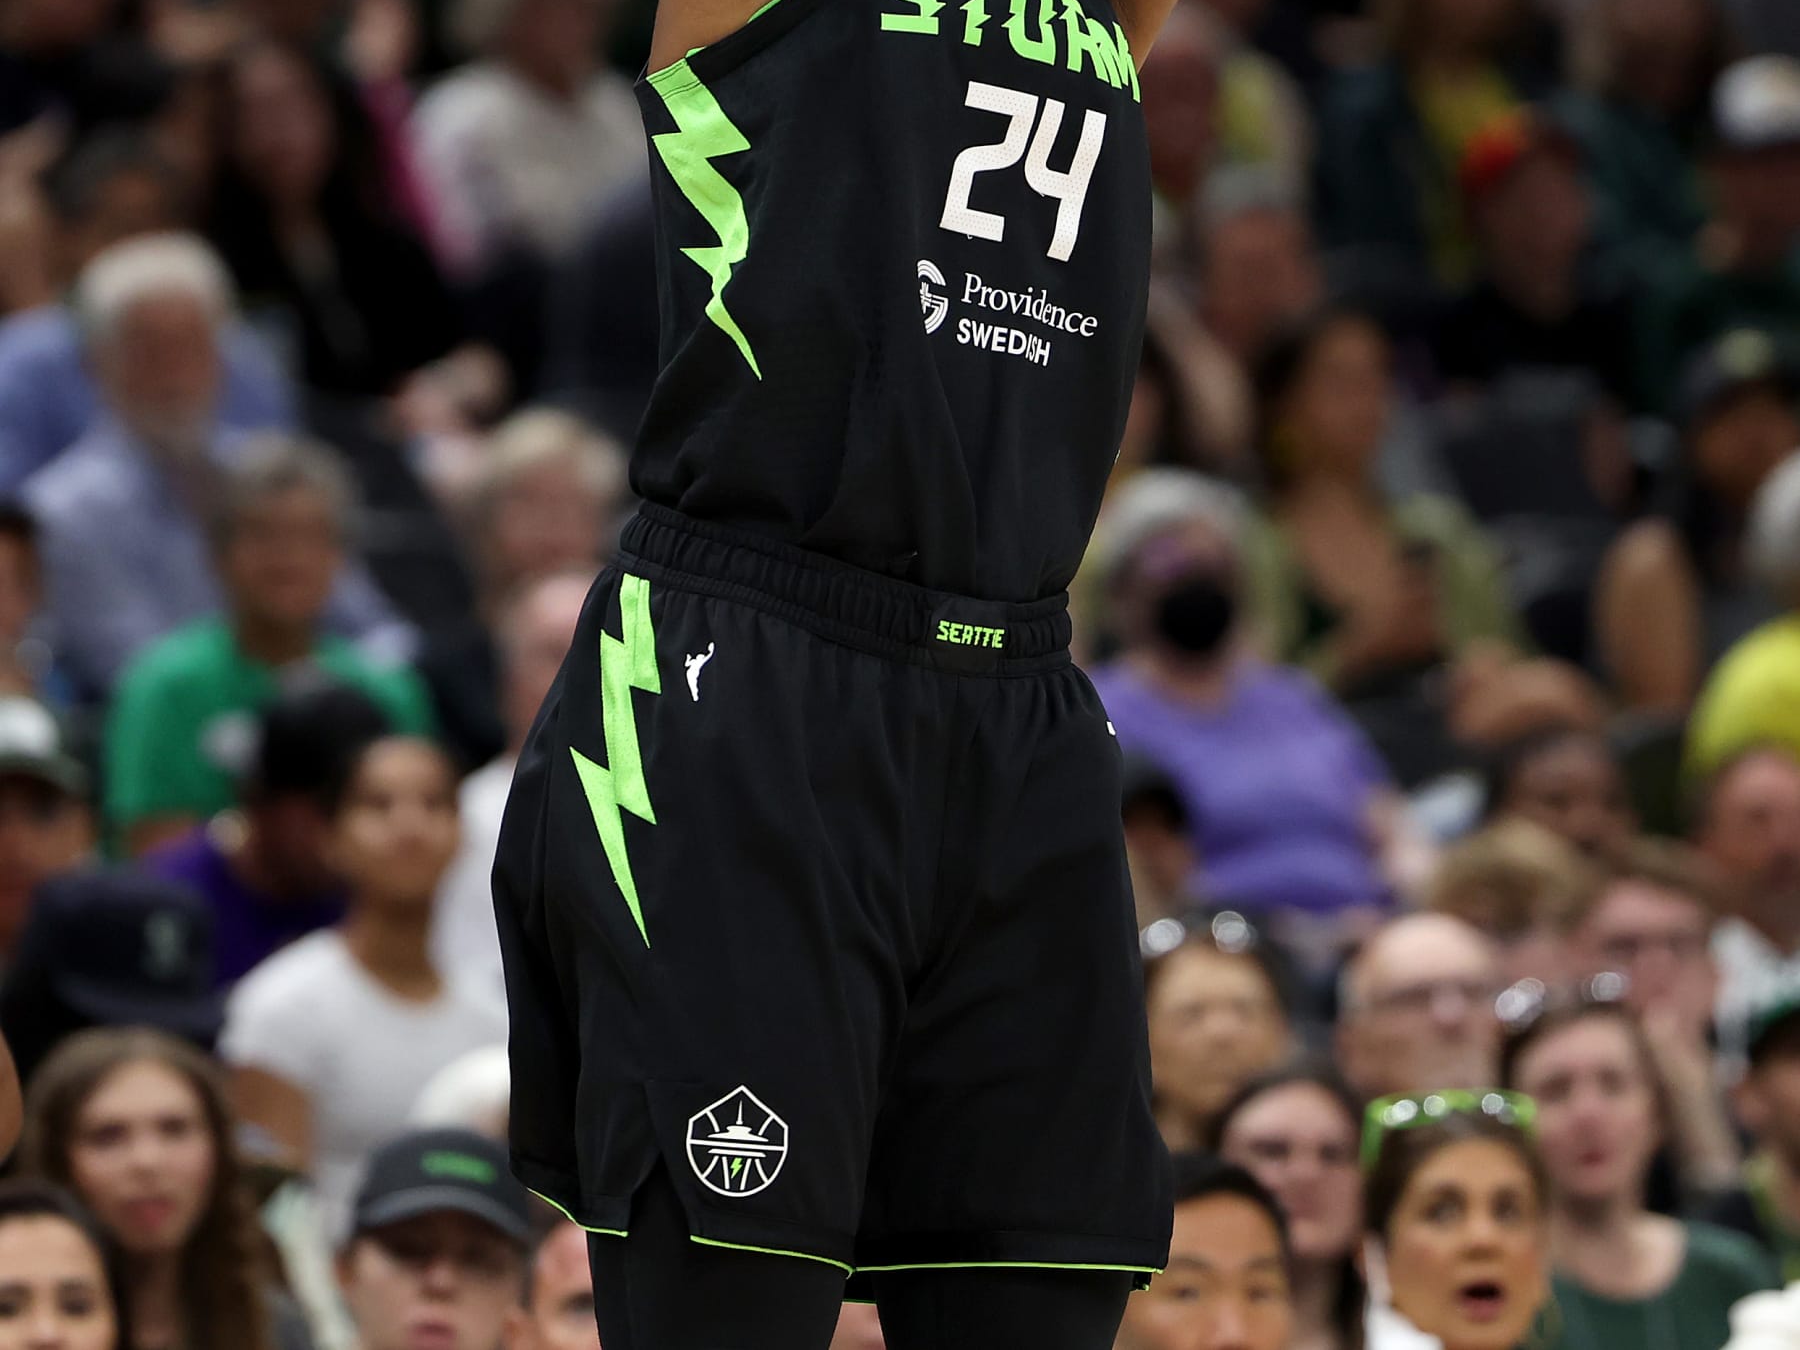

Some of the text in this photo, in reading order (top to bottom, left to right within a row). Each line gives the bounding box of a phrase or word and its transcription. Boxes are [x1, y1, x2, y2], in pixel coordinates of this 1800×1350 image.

[939, 80, 1107, 263] 24
[960, 272, 1099, 338] Providence
[956, 317, 1051, 367] SWEDISH
